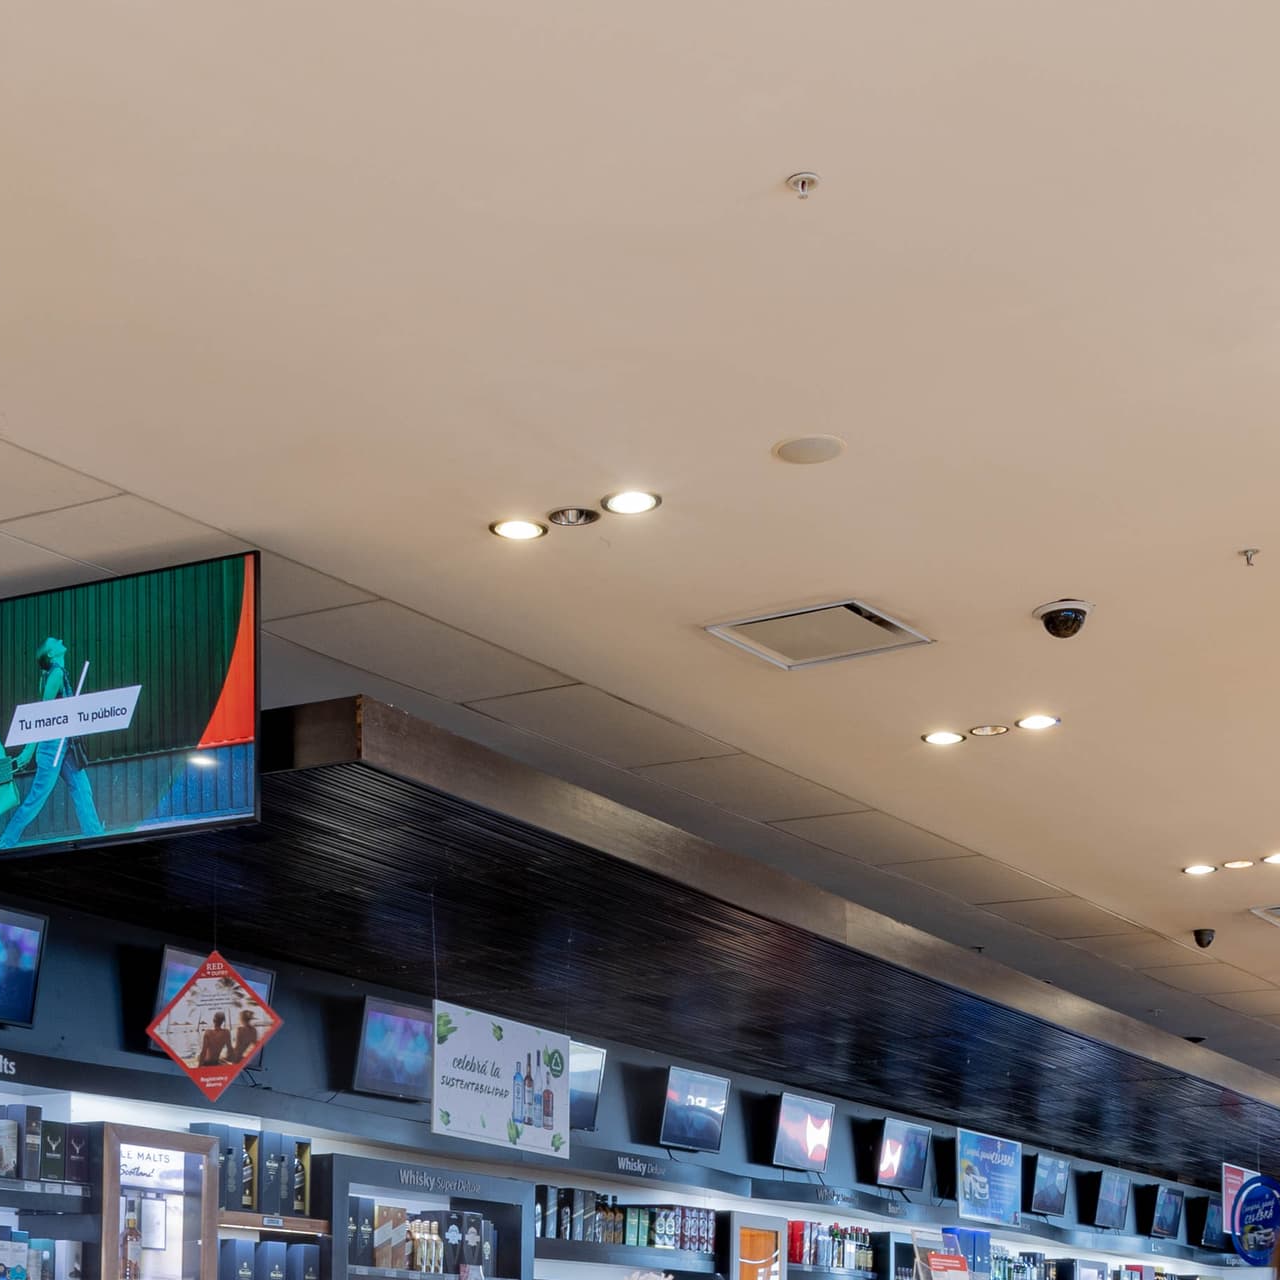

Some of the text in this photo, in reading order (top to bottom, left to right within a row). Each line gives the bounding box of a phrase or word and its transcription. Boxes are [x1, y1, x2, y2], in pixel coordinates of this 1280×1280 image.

[19, 705, 128, 732] Tu marca Tu público
[452, 1054, 501, 1078] celebrá la
[440, 1075, 510, 1098] SUSTENTABILIDAD
[137, 1152, 170, 1163] MALTS
[618, 1156, 647, 1176] Whisky
[400, 1168, 435, 1192] Whisky
